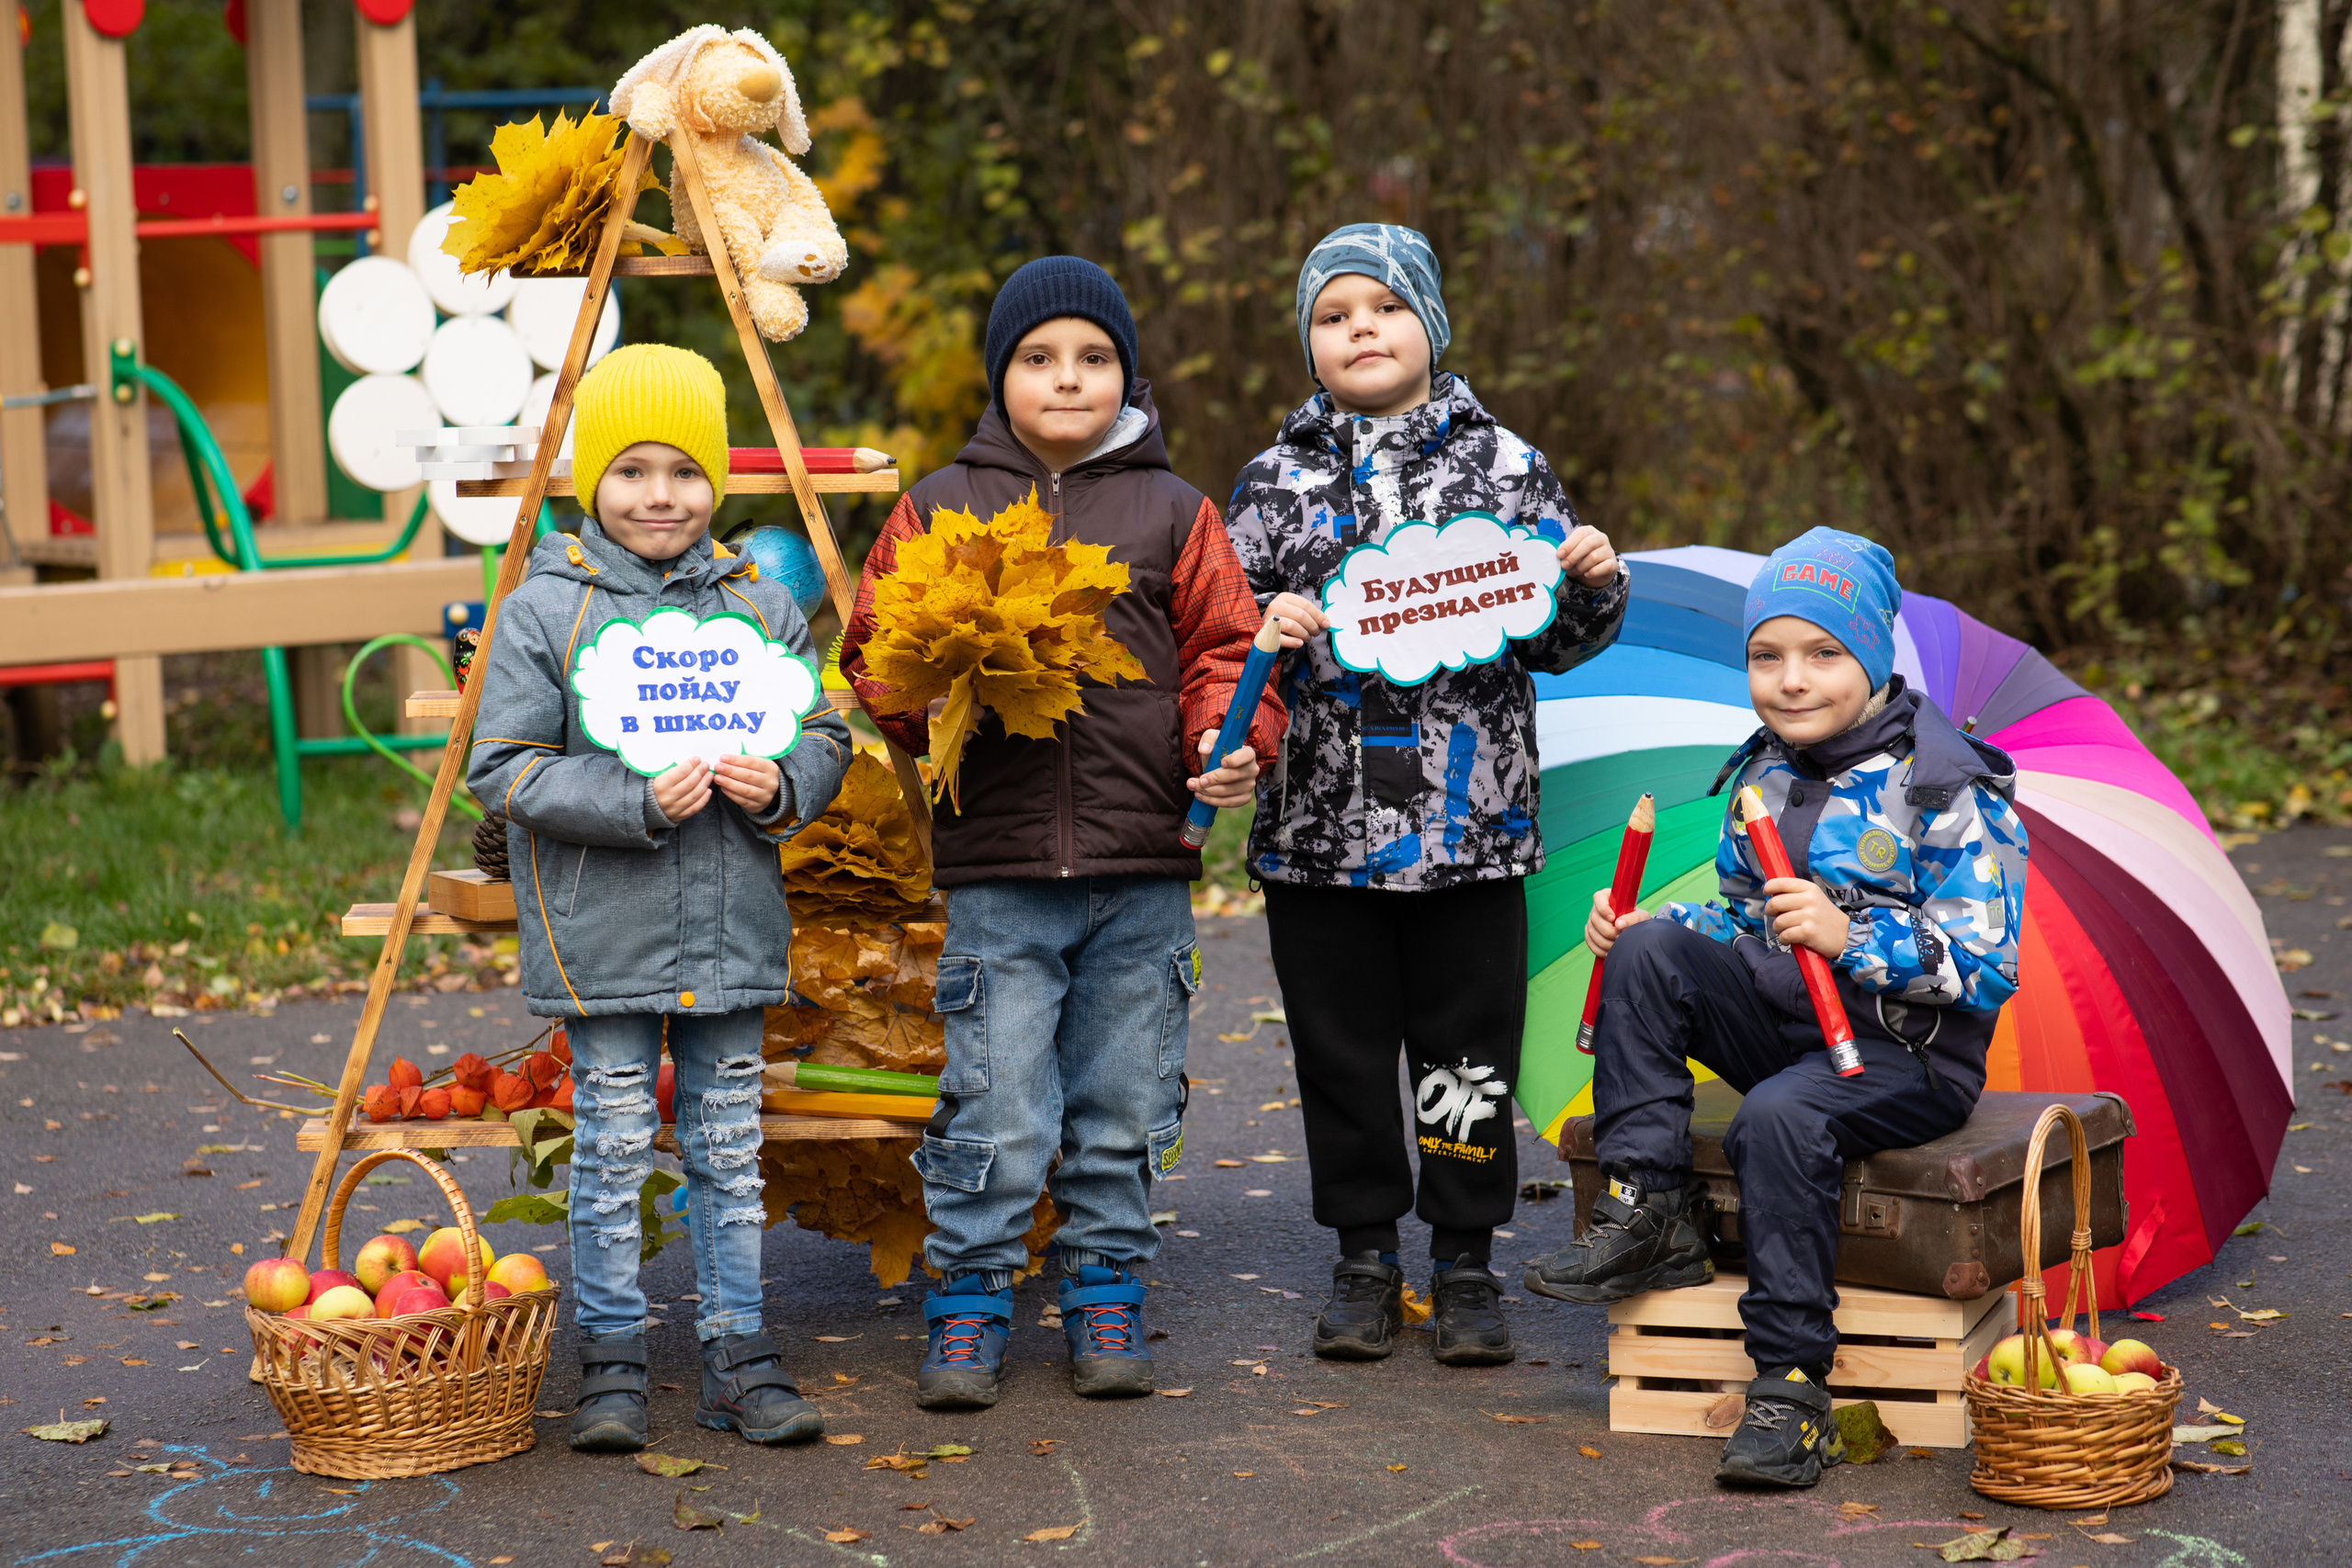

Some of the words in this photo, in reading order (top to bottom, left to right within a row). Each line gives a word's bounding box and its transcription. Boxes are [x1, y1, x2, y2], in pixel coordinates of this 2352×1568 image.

[1361, 551, 1521, 604] Будущий
[1781, 564, 1854, 601] GAME
[1357, 581, 1536, 635] президент
[632, 646, 739, 671] Скоро
[638, 676, 741, 703] пойду
[620, 716, 639, 733] в
[653, 711, 766, 734] школу
[1870, 840, 1886, 860] TR
[1989, 906, 2002, 920] TR
[1419, 1135, 1442, 1149] ONLY
[1442, 1142, 1453, 1151] THE
[1453, 1143, 1497, 1160] FAMILY
[1423, 1147, 1487, 1164] ENTERTAINMENT
